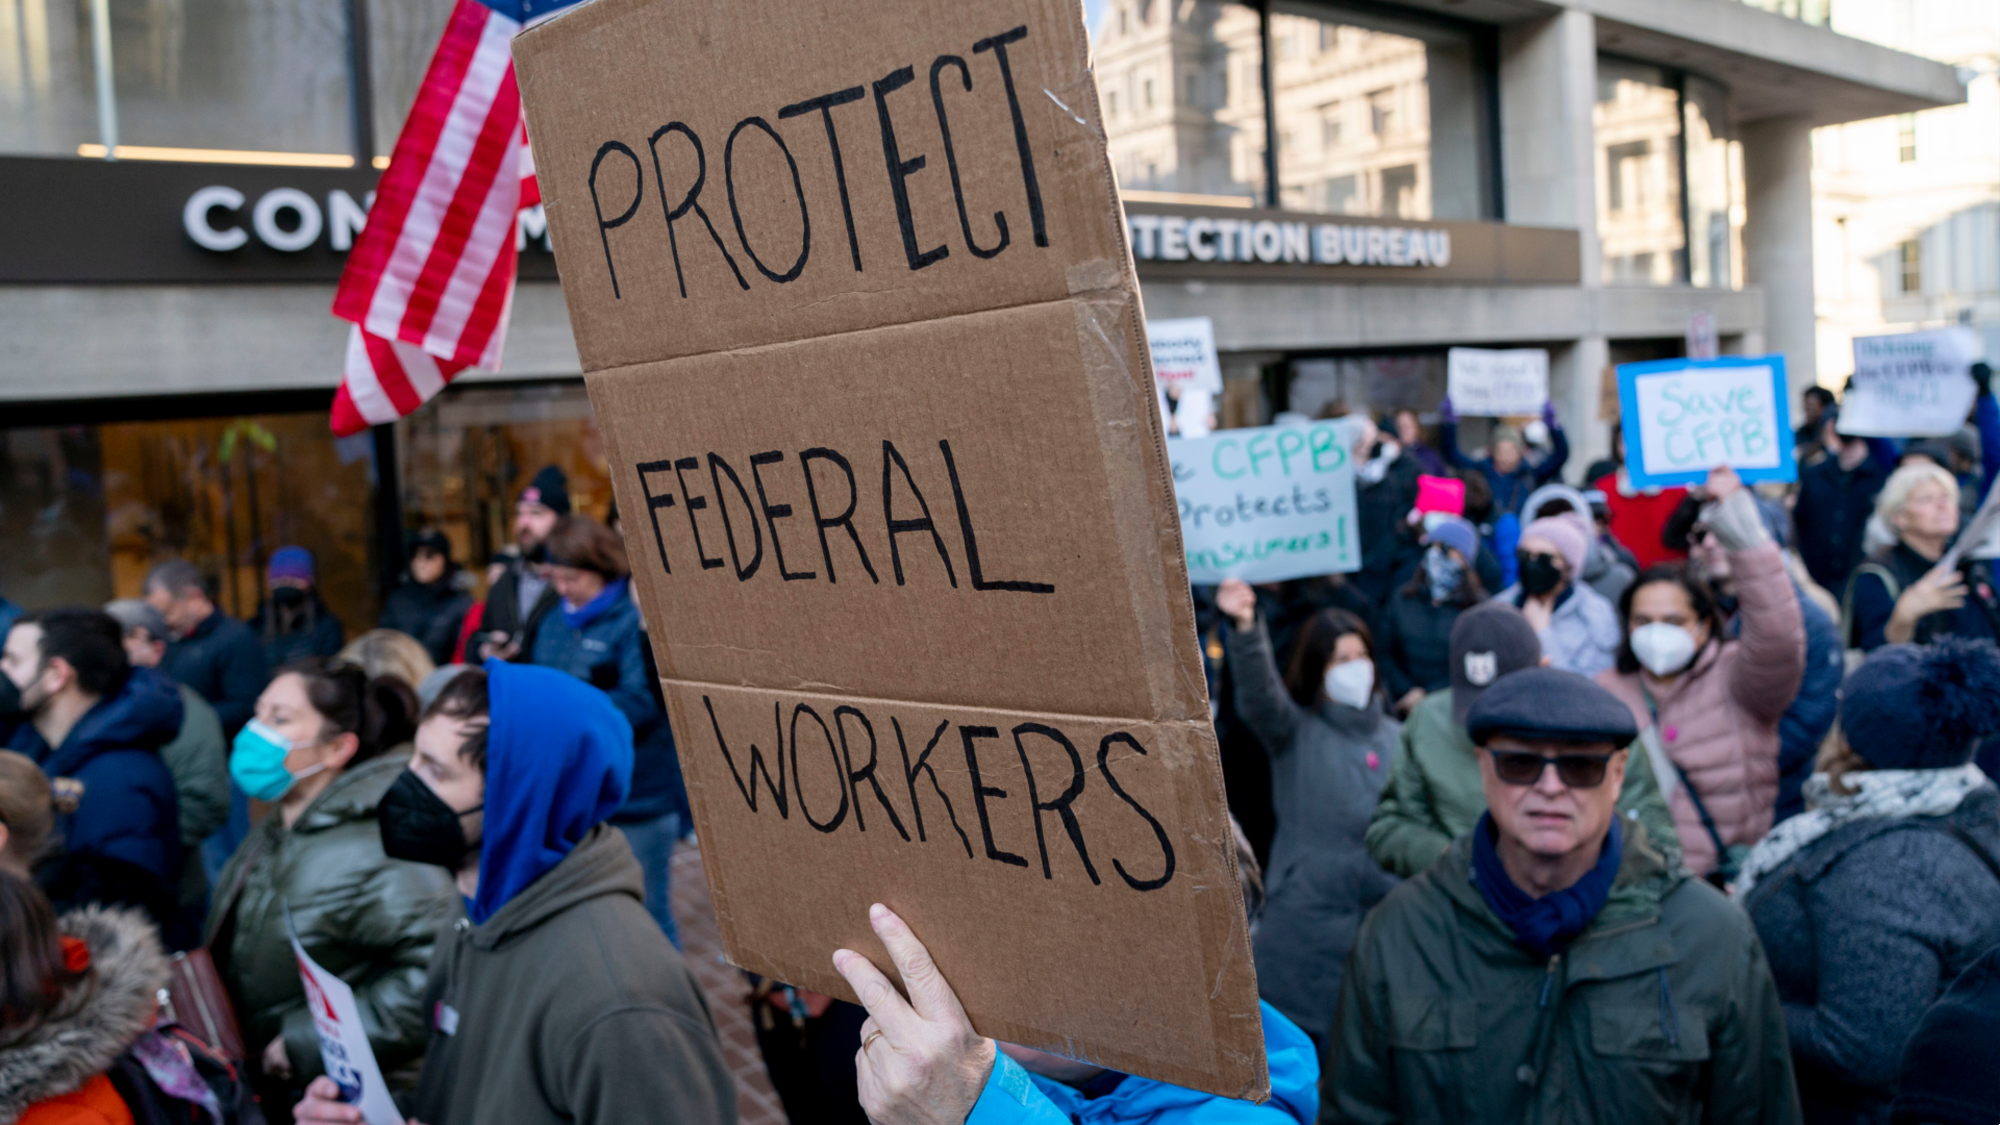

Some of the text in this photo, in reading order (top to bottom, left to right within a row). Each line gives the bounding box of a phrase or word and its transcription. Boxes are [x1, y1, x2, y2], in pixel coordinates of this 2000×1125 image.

[589, 25, 1048, 299] PROTECT
[1127, 215, 1310, 264] TECTION
[1315, 223, 1451, 267] BUREAU
[1657, 379, 1764, 427] Save
[1212, 425, 1346, 481] CFPB
[1664, 418, 1769, 466] CFPB
[636, 439, 1055, 593] FEDERAL
[1186, 514, 1347, 571] onsumers!
[703, 695, 1176, 892] WORKERS
